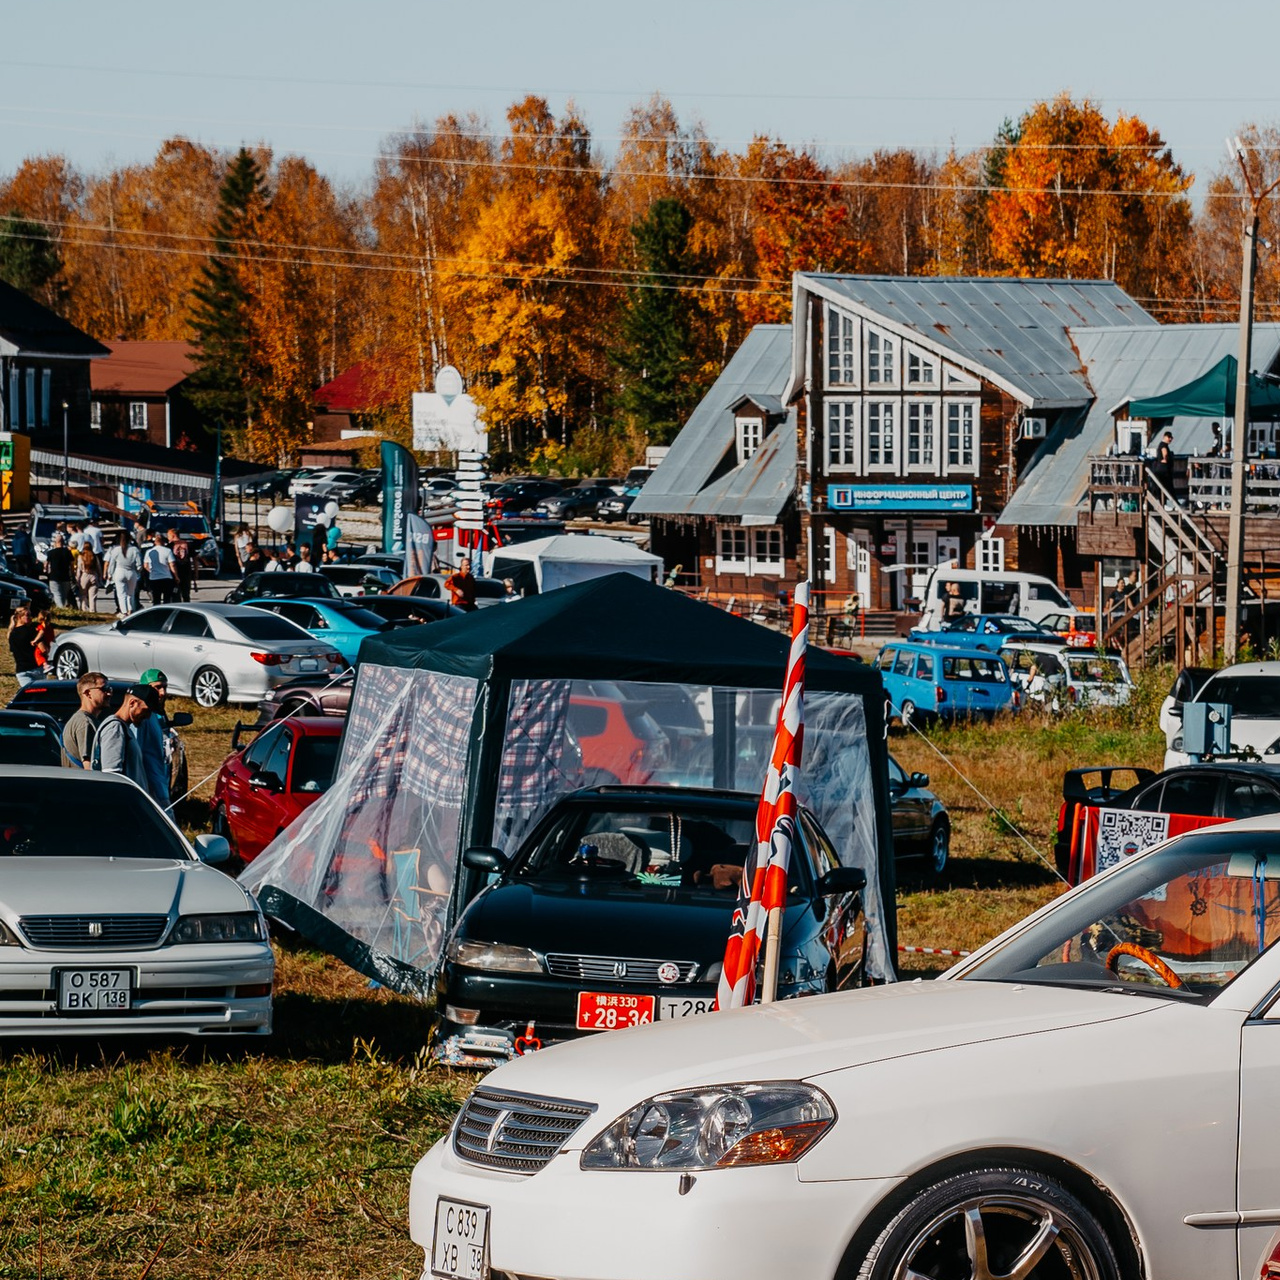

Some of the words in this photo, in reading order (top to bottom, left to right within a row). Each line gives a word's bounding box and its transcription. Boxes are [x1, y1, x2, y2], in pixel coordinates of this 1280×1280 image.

[853, 489, 938, 500] ИНФОРМАЦИОННЫЙ
[939, 490, 967, 500] ЦЕНТР
[89, 972, 120, 988] 587
[102, 991, 127, 1004] 138
[457, 1208, 478, 1240] 839
[470, 1248, 482, 1272] 38
